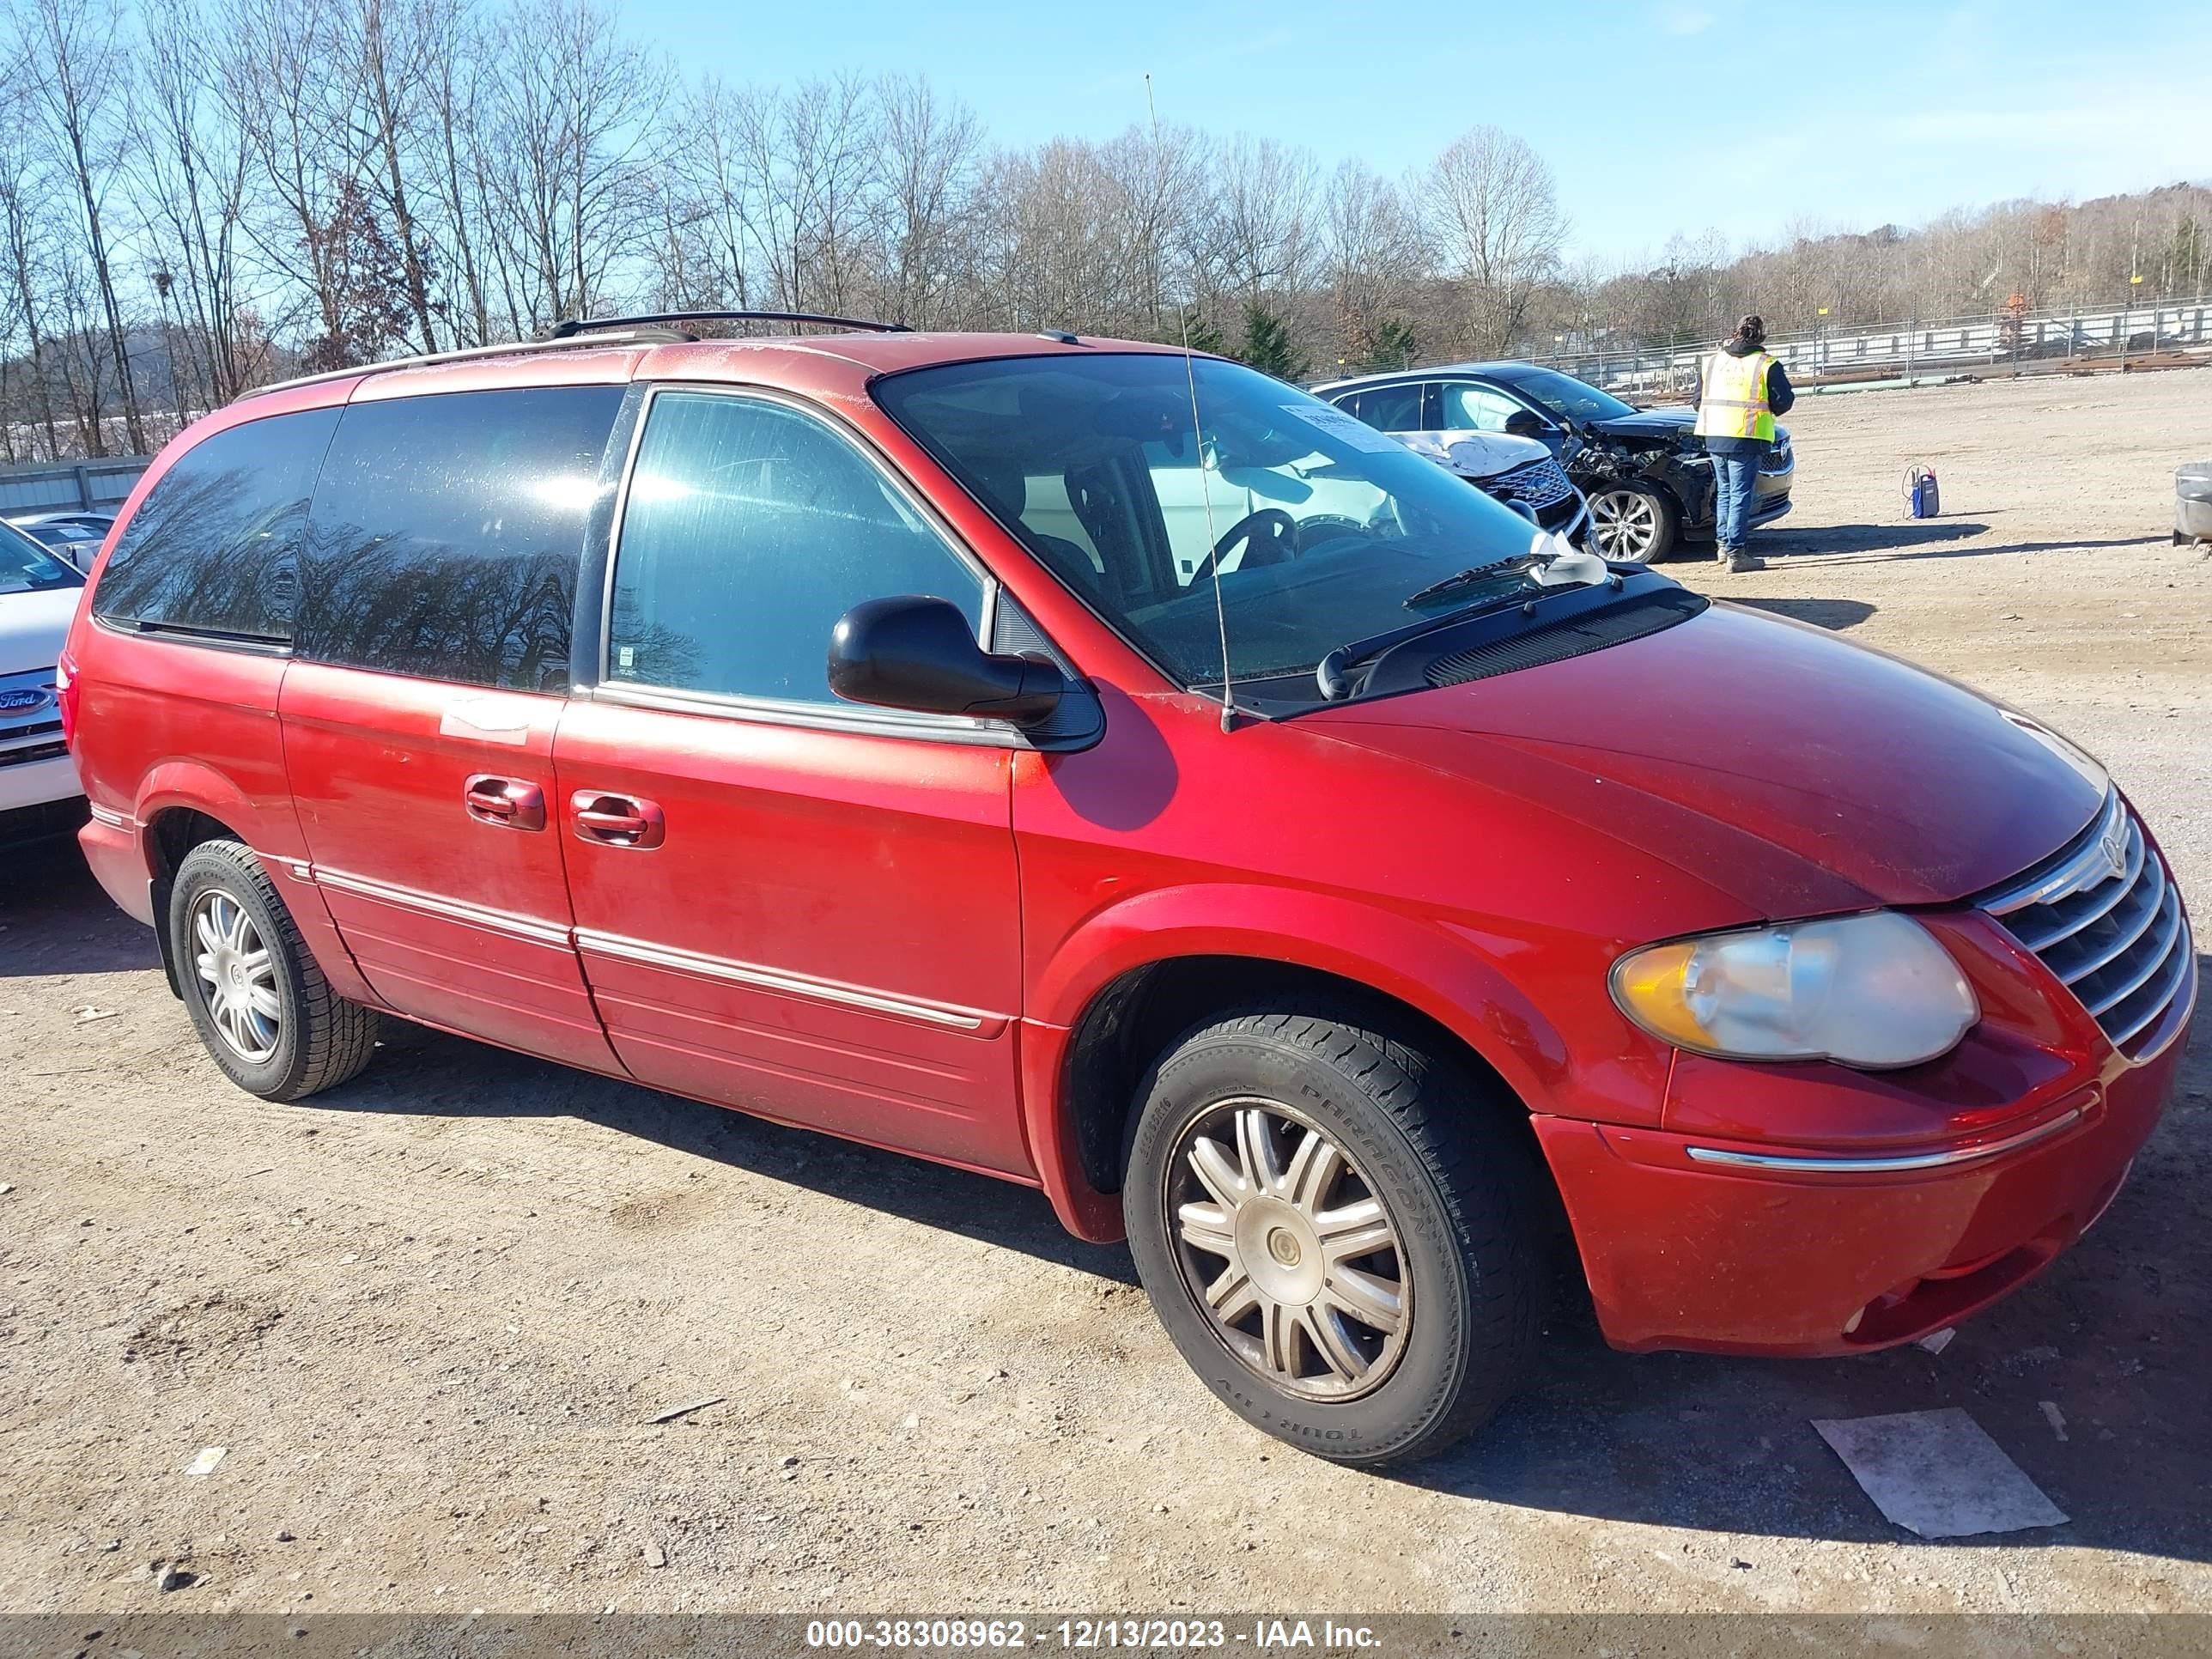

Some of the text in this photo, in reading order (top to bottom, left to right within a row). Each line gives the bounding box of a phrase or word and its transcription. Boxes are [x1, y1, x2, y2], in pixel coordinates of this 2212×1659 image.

[0, 692, 35, 708] Ford
[1299, 1084, 1431, 1241] PARAGON
[1279, 1418, 1364, 1442] TOUR
